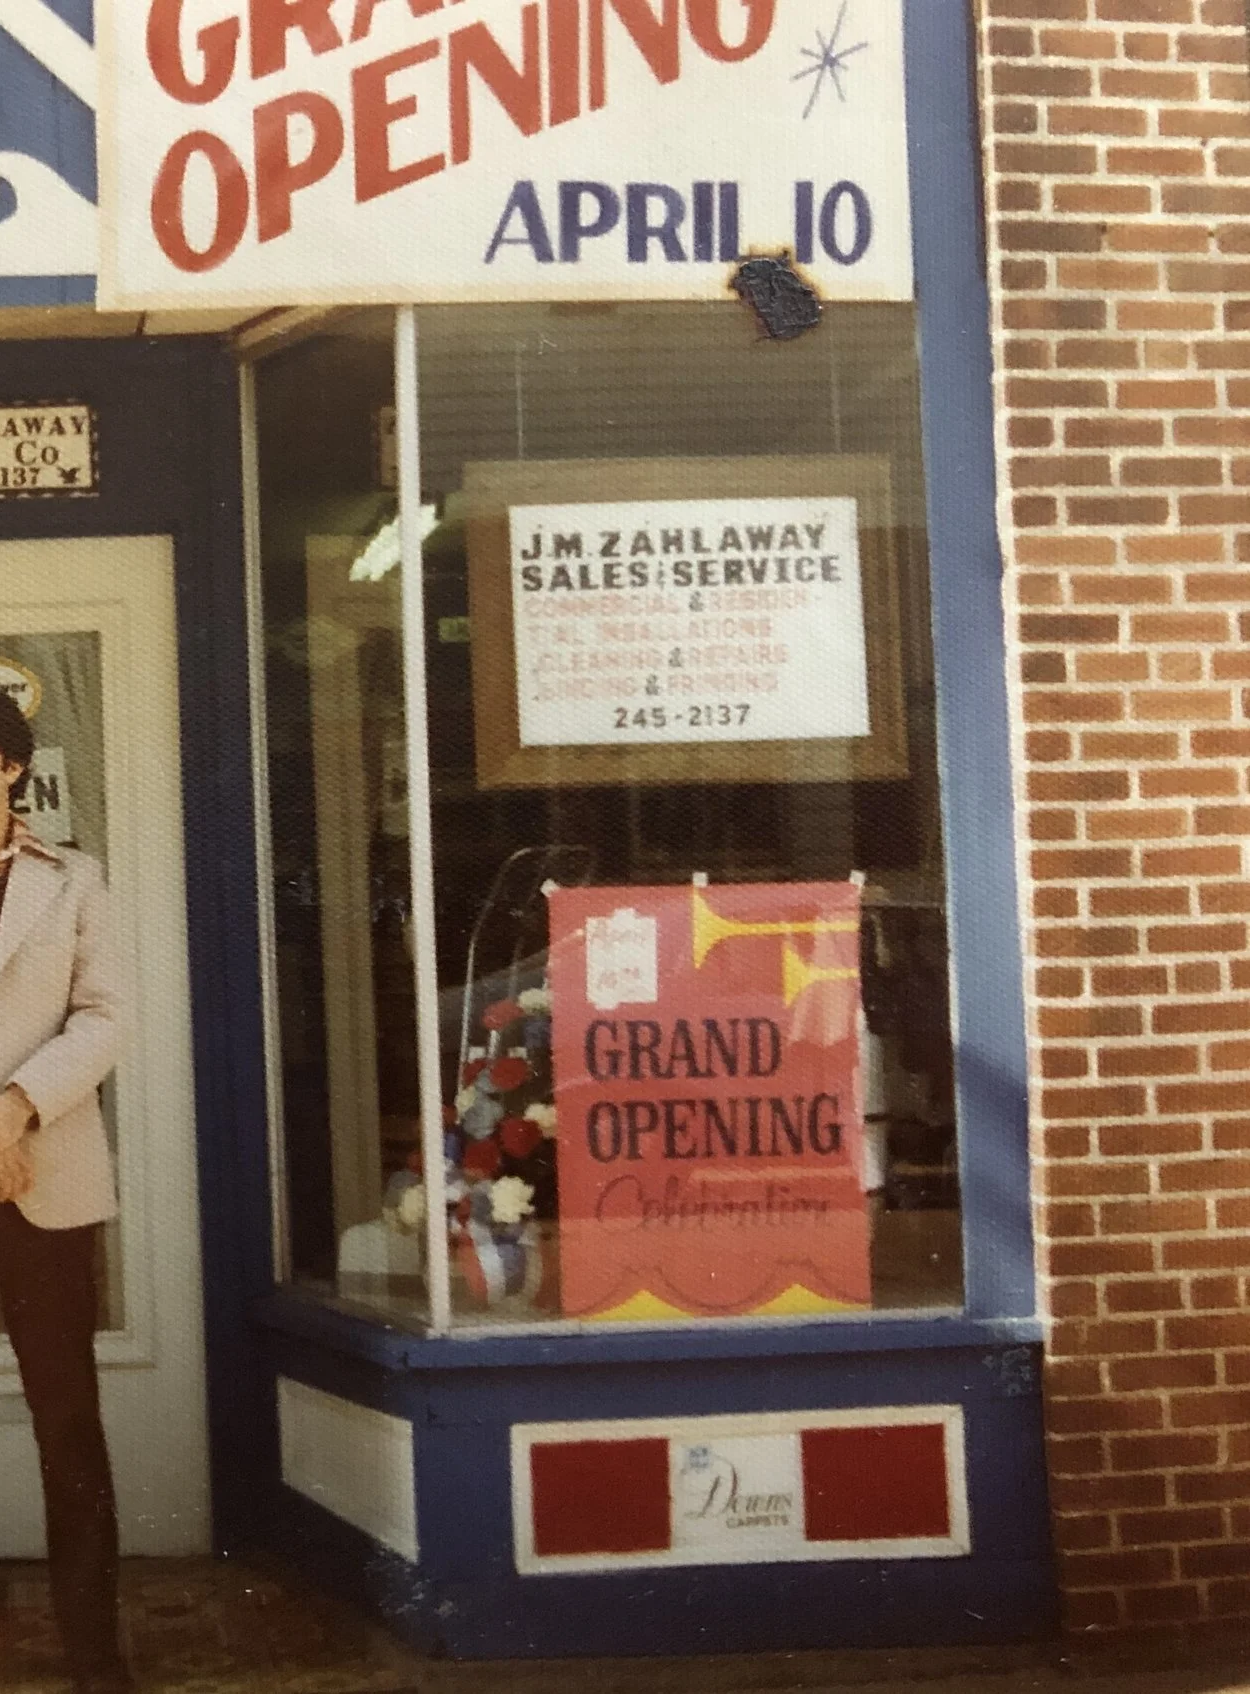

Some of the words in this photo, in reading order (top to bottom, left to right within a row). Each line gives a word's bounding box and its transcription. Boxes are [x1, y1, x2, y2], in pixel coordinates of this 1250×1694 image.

[795, 179, 872, 266] 10
[599, 523, 826, 558] ZAHLAWAY
[521, 561, 650, 592] SALES
[672, 555, 843, 588] SERVICE
[688, 590, 704, 612] &
[667, 646, 683, 668] &
[645, 674, 660, 696] &
[613, 704, 752, 730] 245-2137
[584, 1016, 783, 1083] GRAND
[586, 1092, 844, 1165] OPENING
